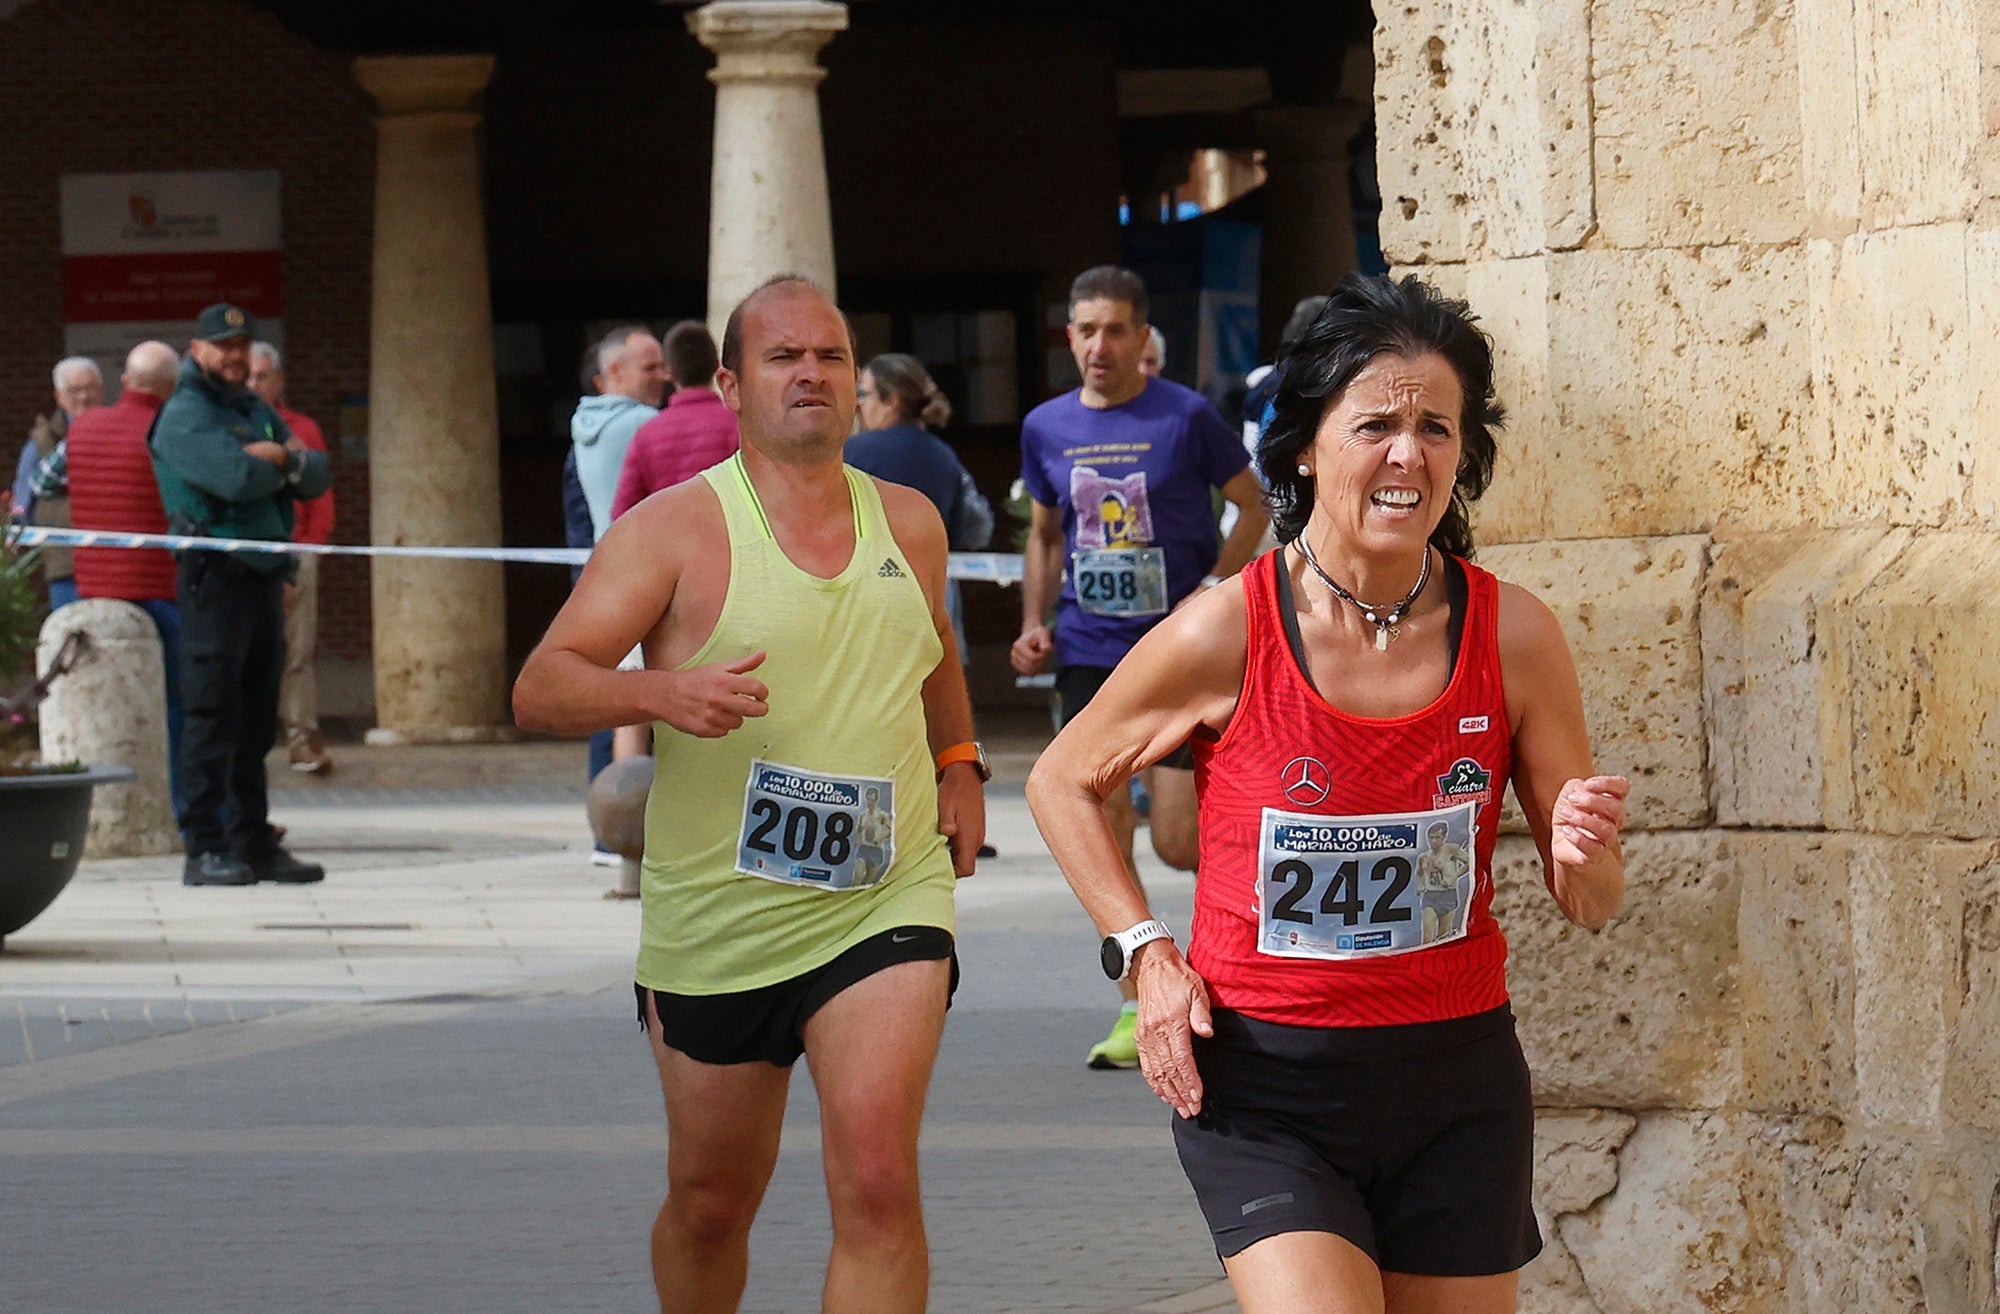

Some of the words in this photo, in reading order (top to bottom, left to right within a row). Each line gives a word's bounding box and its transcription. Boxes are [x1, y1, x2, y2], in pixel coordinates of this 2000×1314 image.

[878, 570, 907, 578] adidas
[1080, 571, 1137, 600] 298
[1462, 720, 1486, 729] 42K
[785, 776, 834, 794] 10.000
[1449, 782, 1484, 794] cuatro
[763, 782, 818, 801] MARIANO
[820, 794, 852, 805] HARO
[746, 798, 854, 866] 208
[1289, 829, 1310, 839] Los
[1310, 827, 1378, 842] 10.000
[1284, 839, 1358, 851] MARIANO
[1362, 838, 1406, 850] HARO
[1271, 856, 1412, 926] 242
